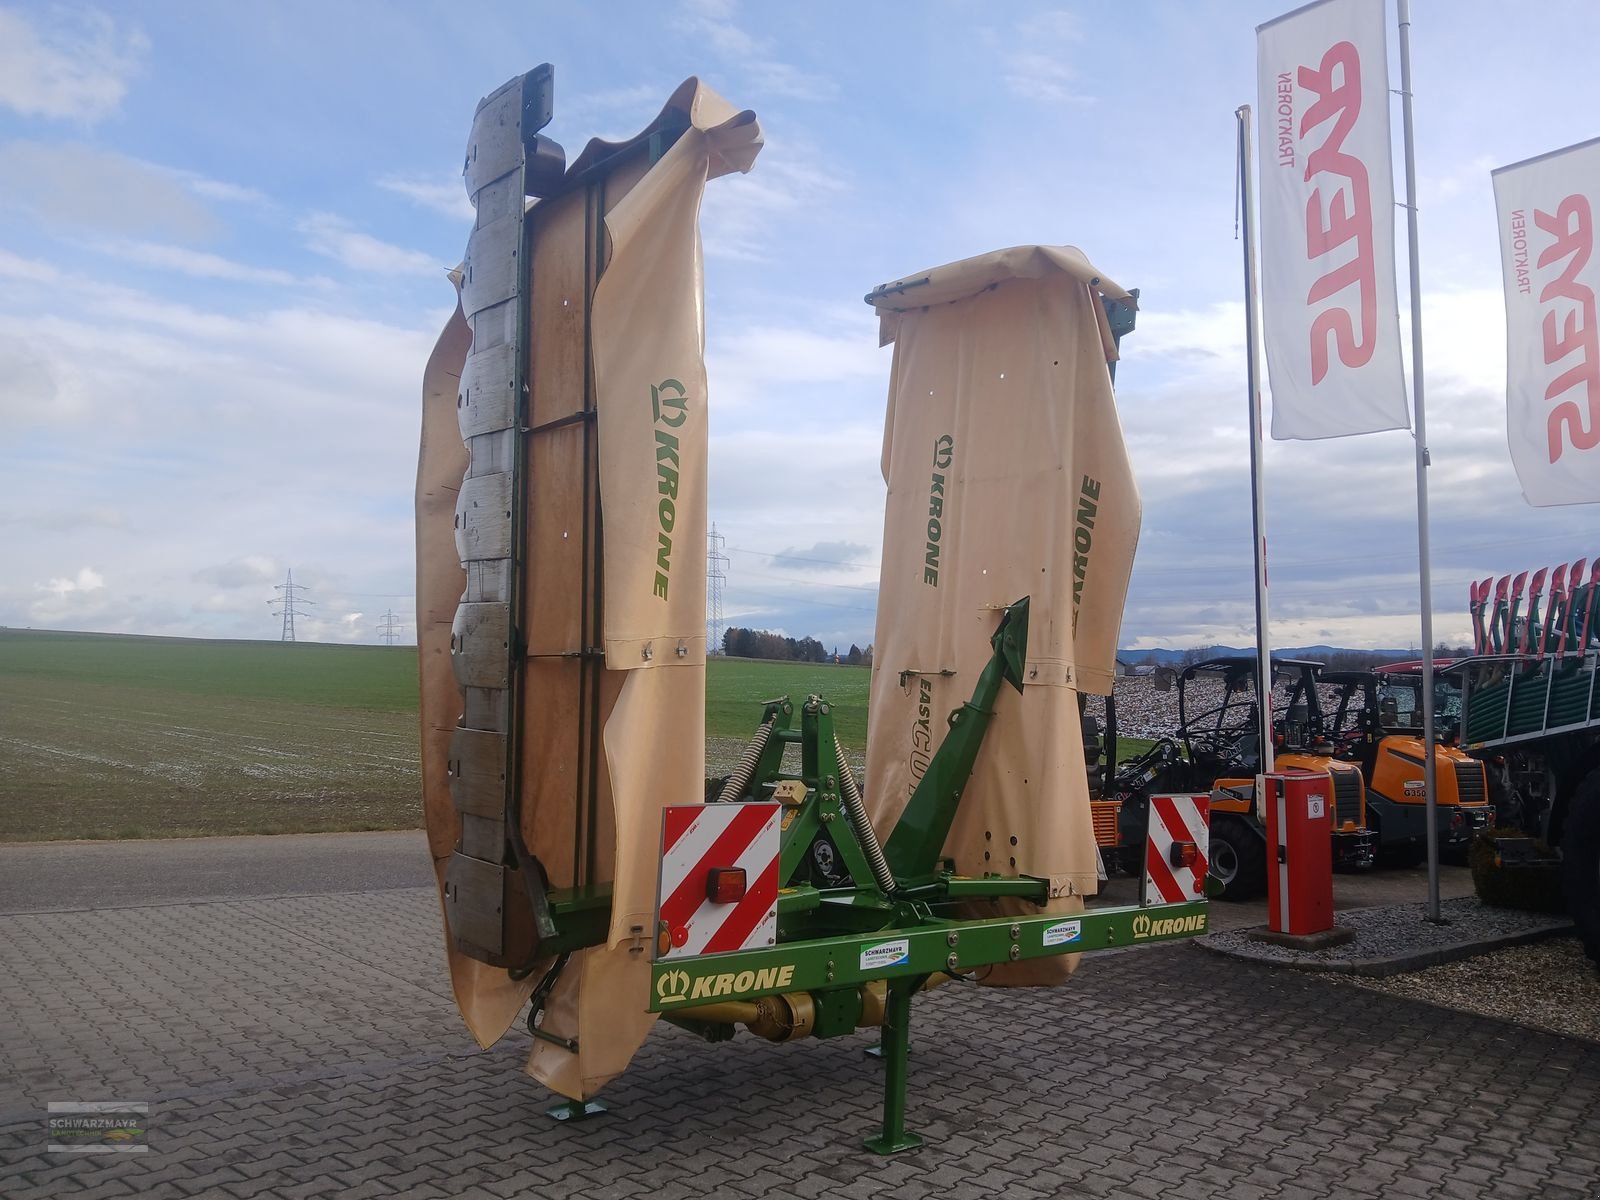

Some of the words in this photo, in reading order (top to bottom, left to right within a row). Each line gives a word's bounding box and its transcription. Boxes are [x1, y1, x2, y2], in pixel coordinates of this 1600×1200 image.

[653, 429, 680, 602] KRONE
[923, 473, 945, 588] KRONE
[1404, 789, 1426, 797] G350
[1150, 914, 1206, 936] KRONE
[690, 965, 795, 999] KRONE
